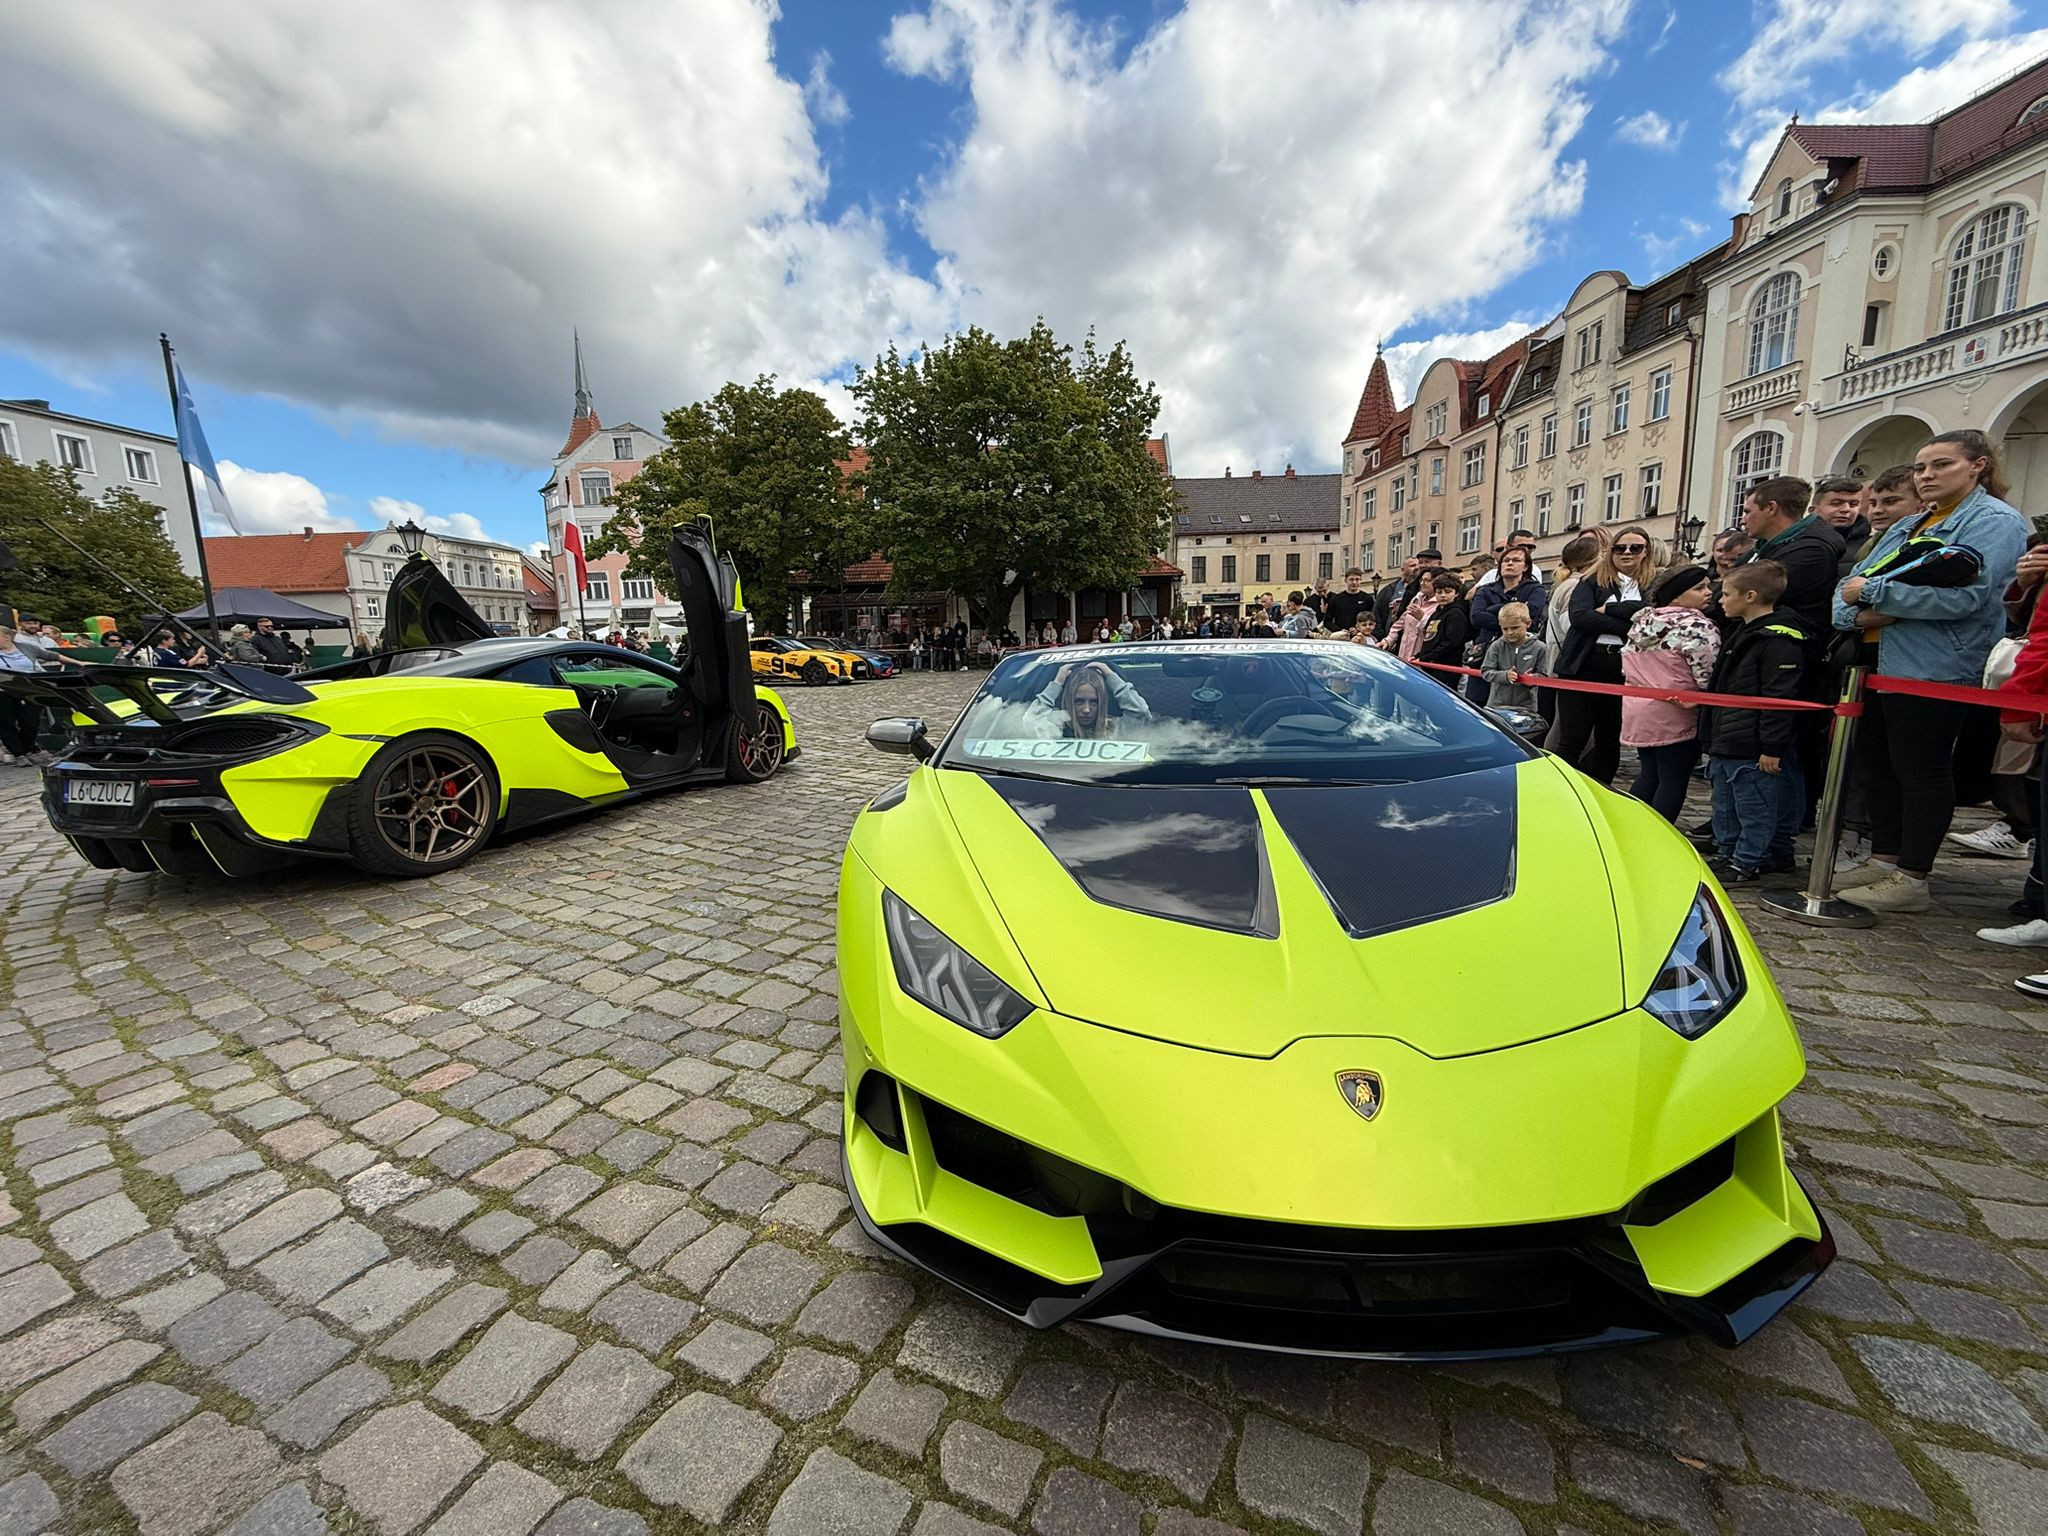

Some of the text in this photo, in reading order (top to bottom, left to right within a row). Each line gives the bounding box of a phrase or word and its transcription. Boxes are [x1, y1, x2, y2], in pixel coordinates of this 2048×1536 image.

[770, 656, 784, 674] 9
[1030, 740, 1143, 761] CZUCZ
[89, 782, 132, 803] CZUCZ
